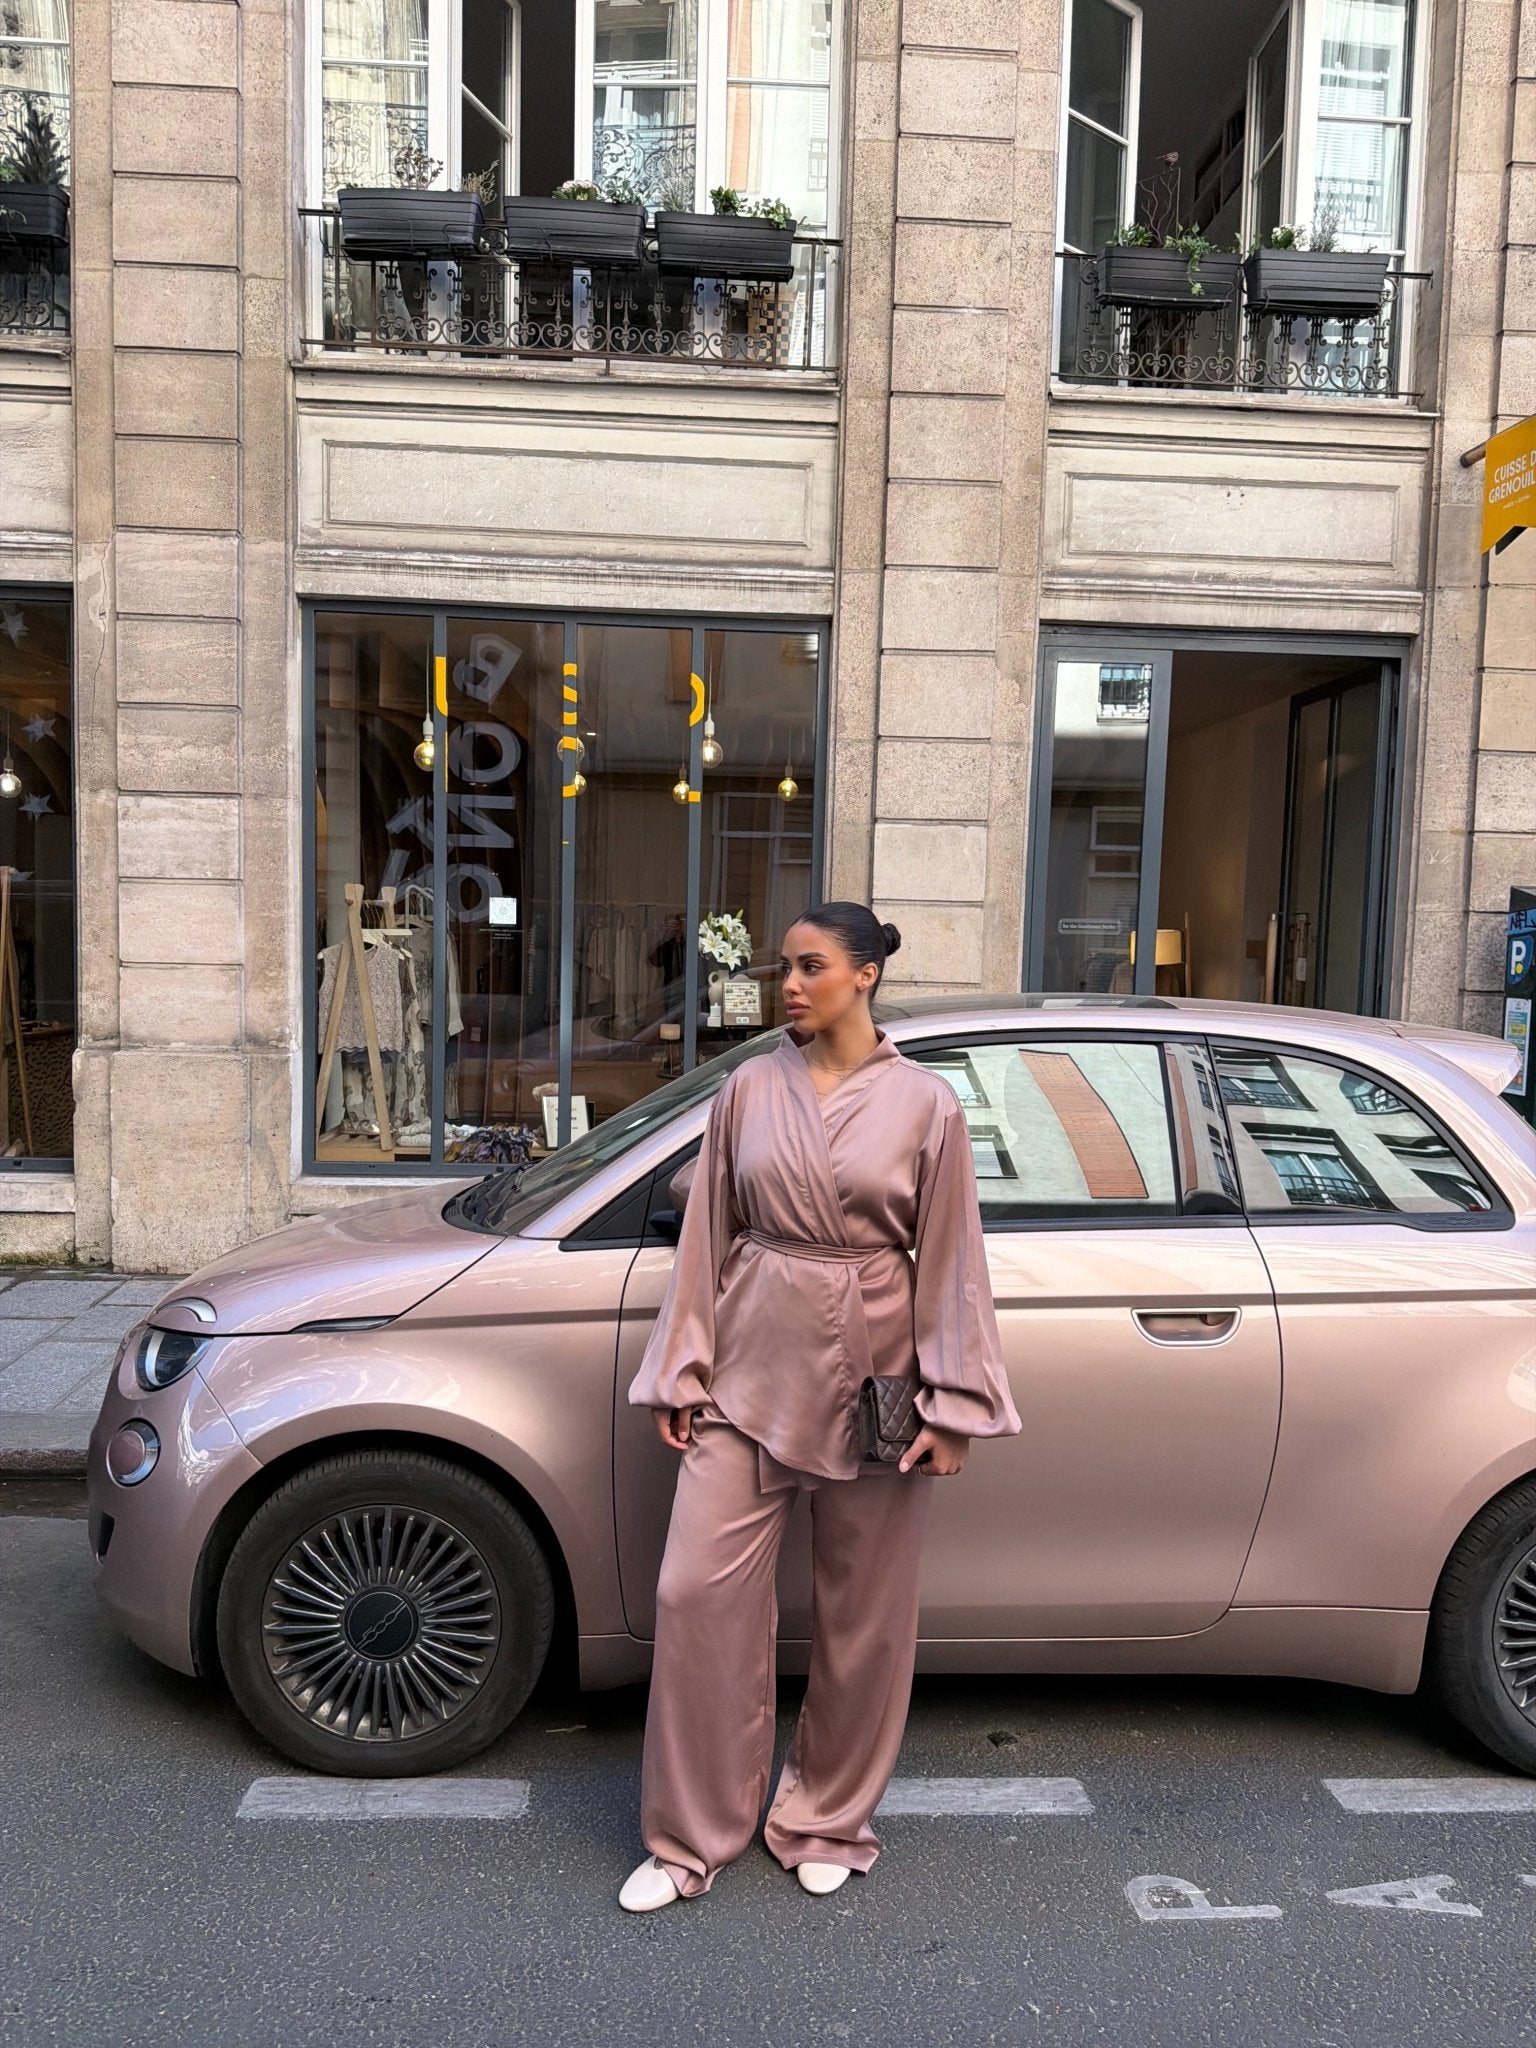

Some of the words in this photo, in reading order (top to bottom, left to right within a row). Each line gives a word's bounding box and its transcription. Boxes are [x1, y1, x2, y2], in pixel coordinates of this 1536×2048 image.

[1494, 454, 1527, 483] CUISSE
[1488, 469, 1536, 504] GRENOUIL
[1511, 940, 1526, 975] P
